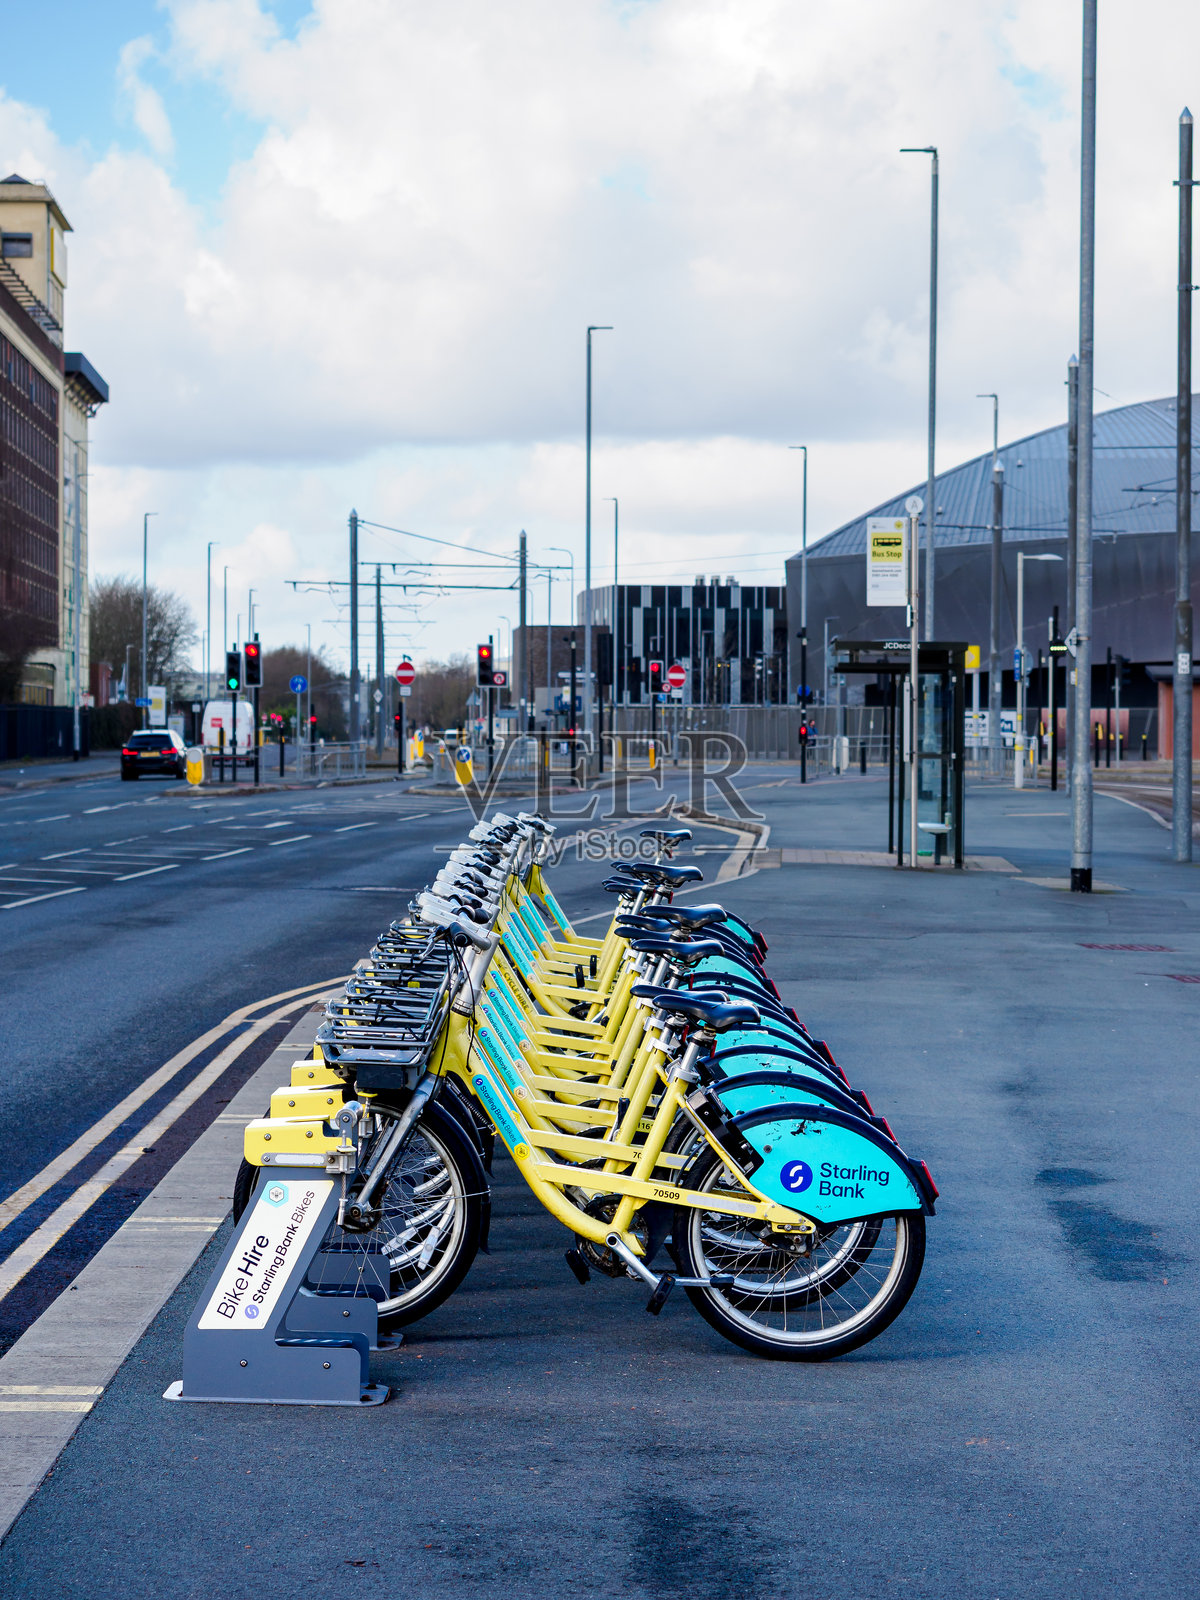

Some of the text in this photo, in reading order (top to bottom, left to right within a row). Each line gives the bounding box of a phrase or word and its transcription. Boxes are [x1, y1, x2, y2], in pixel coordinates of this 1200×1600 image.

[911, 500, 919, 509] A
[886, 551, 902, 559] Stop
[503, 972, 519, 993] CYCLE
[516, 993, 530, 1010] HIRE
[493, 997, 505, 1016] Starling
[485, 1036, 516, 1085] Starling Bank Bikes
[480, 1085, 518, 1142] Starling Bank Bikes
[820, 1162, 890, 1187] Starling
[653, 1188, 680, 1200] 70509
[819, 1180, 865, 1199] Bank
[252, 1190, 315, 1304] Starling Bank Bikes
[216, 1234, 269, 1319] Bike Hire
